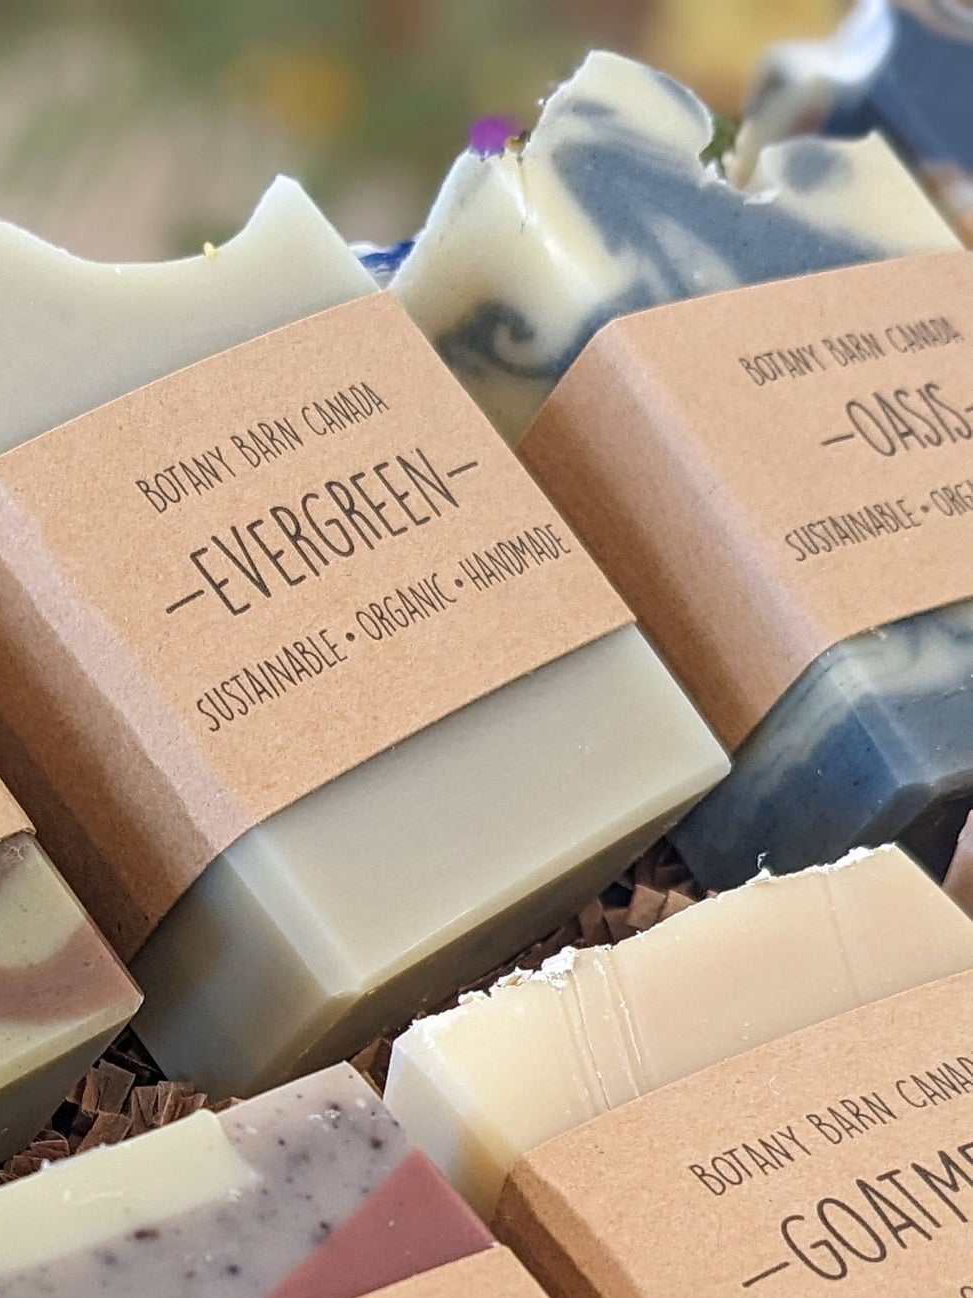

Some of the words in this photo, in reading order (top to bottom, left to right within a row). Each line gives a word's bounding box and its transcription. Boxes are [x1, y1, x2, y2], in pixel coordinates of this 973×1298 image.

[738, 345, 826, 386] BOTANY
[821, 333, 886, 367] BARN
[136, 446, 236, 513] BOTANY
[230, 418, 303, 468] BARN
[302, 382, 389, 435] CANADA
[785, 500, 921, 561] SUSTAINABLE
[197, 629, 347, 732] SUSTAINABLE
[356, 573, 457, 640] ORGANIC
[458, 524, 571, 591] HANDMADE
[689, 1126, 811, 1195] BOTANY
[806, 1092, 897, 1144] BARN
